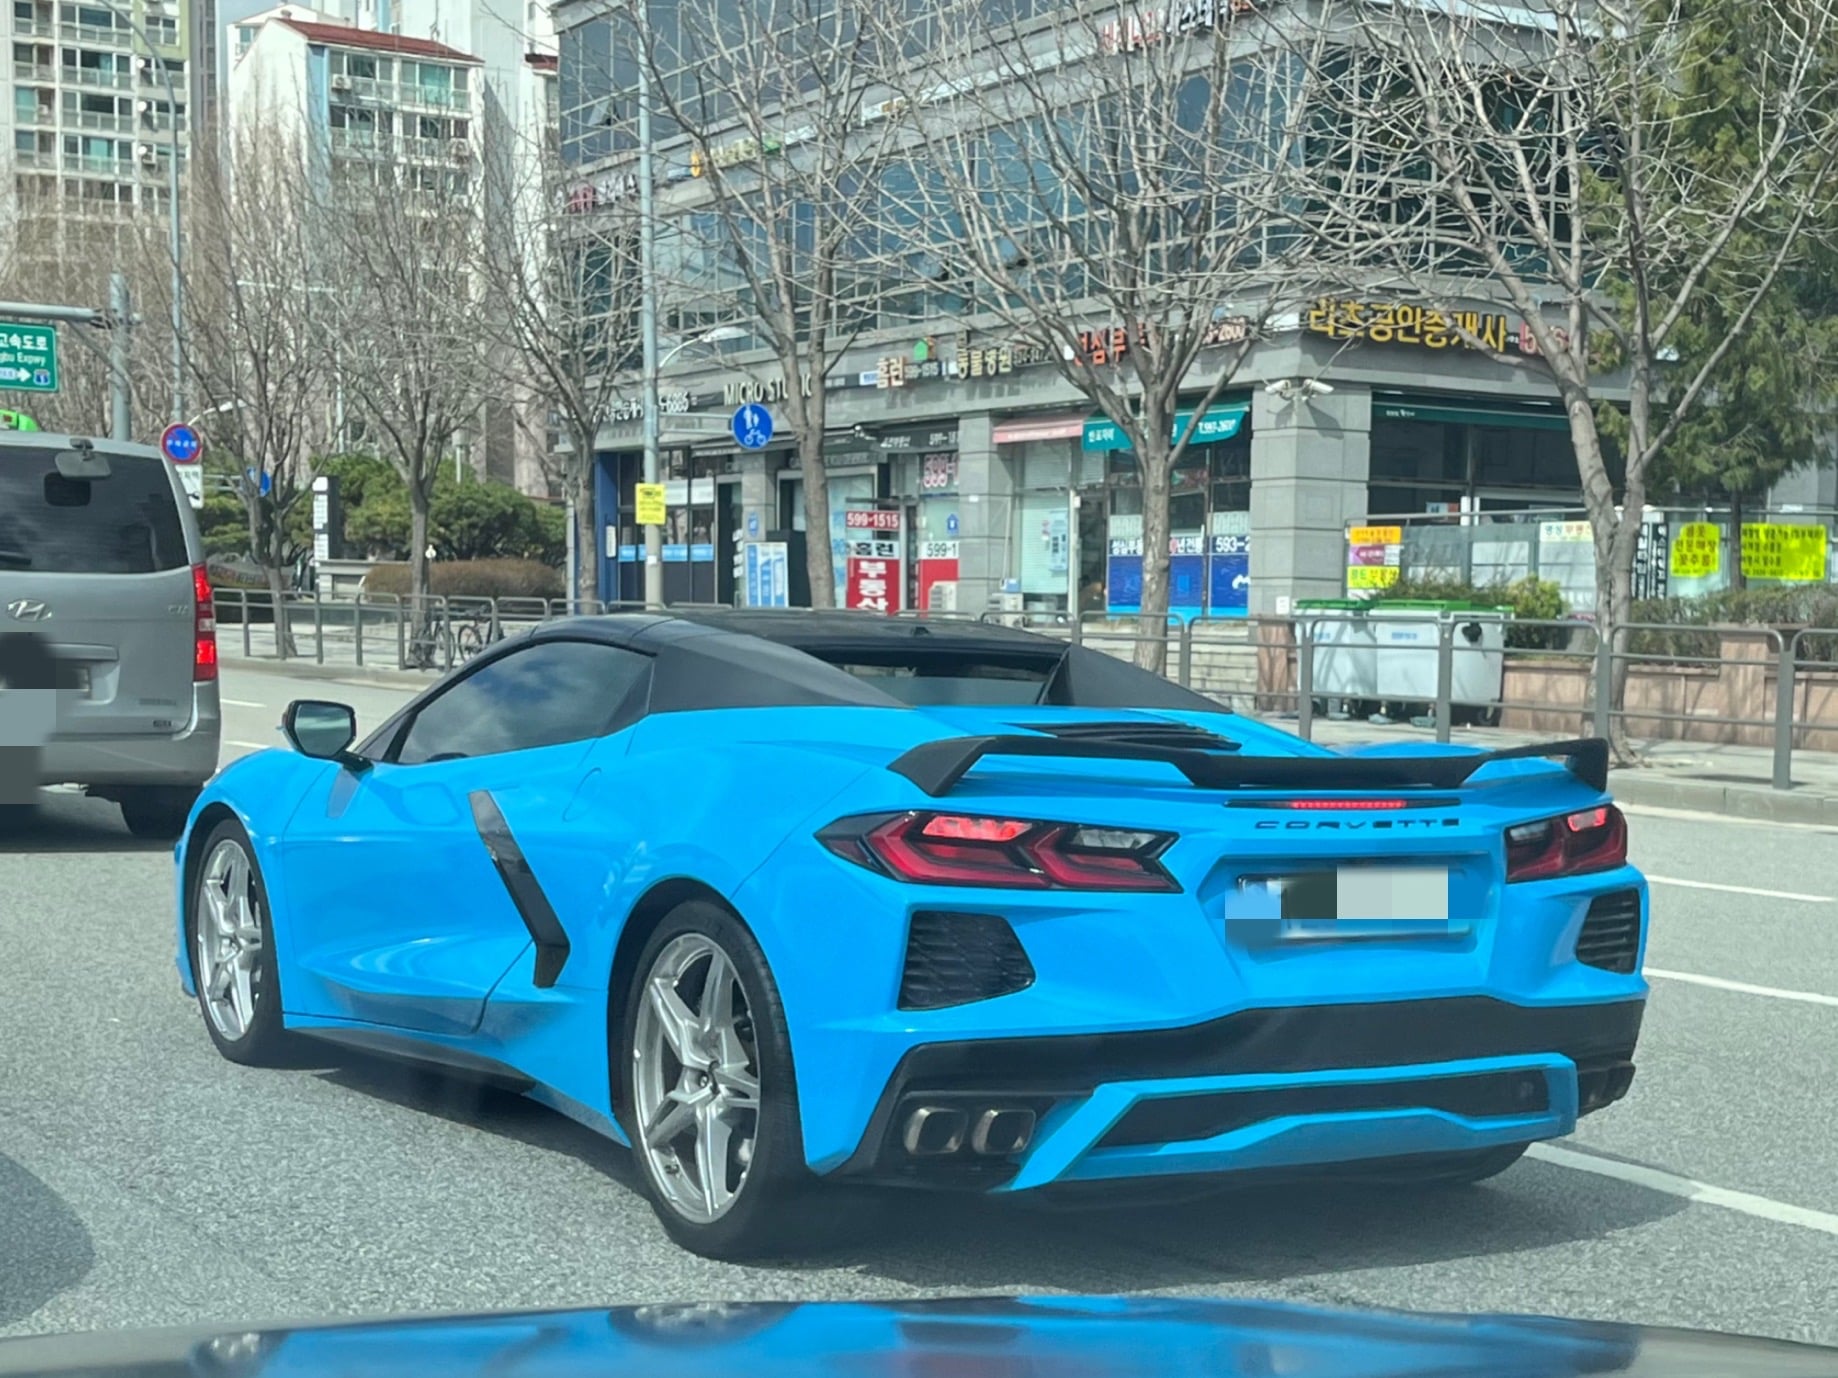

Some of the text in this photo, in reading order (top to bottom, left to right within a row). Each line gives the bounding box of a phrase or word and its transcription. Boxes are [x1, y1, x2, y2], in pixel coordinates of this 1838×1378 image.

[724, 381, 764, 405] MICRO
[767, 373, 813, 402] STUIO
[846, 512, 899, 528] 599-1515
[926, 543, 957, 557] 599-1
[1254, 818, 1460, 830] CORVETTE
